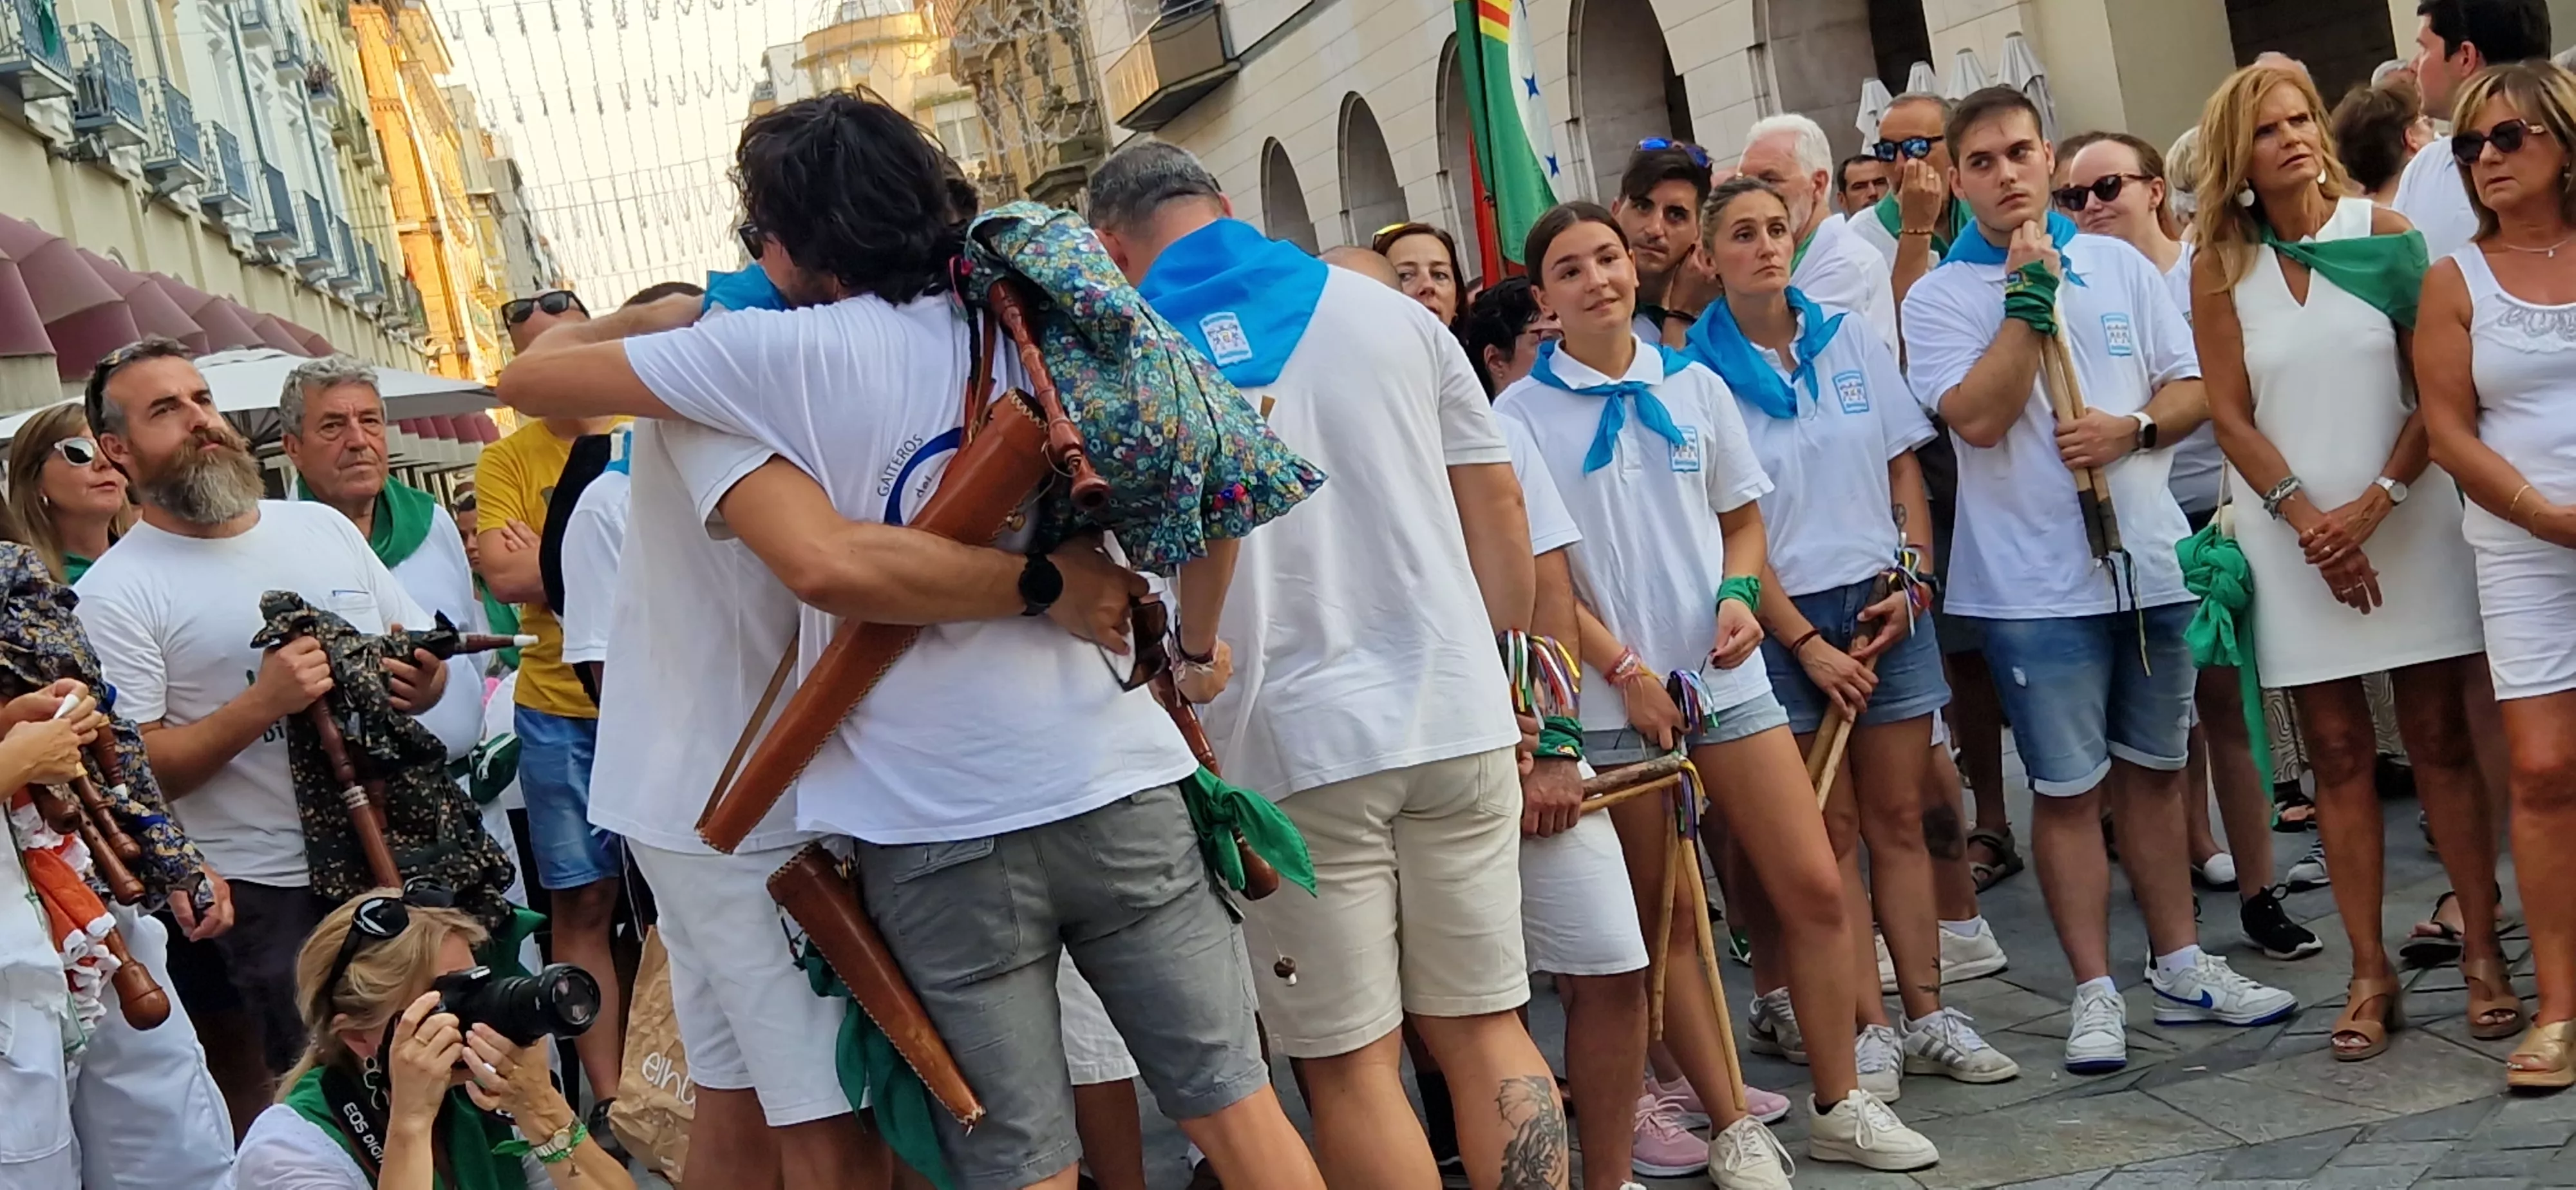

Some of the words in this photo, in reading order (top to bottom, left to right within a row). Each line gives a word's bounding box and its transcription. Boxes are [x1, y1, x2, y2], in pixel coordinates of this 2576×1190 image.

[877, 434, 923, 496] GAITEROS
[916, 475, 932, 498] del
[343, 1102, 369, 1133] EOS
[363, 1133, 384, 1164] DIGI
